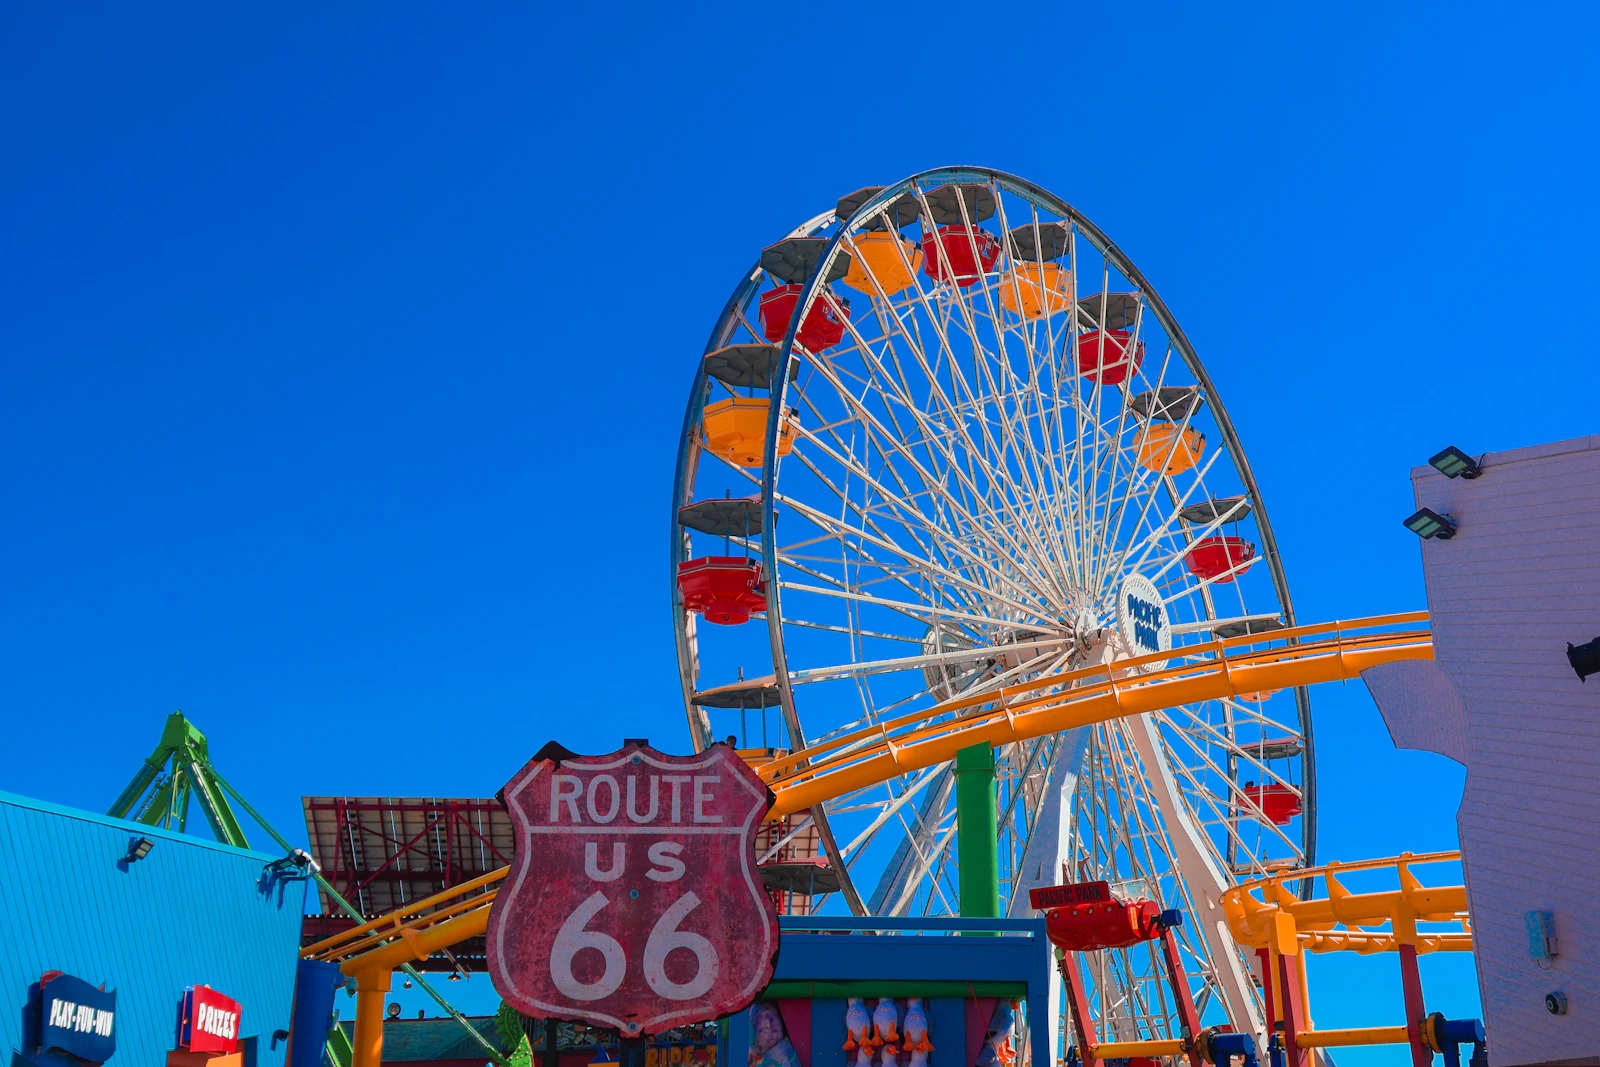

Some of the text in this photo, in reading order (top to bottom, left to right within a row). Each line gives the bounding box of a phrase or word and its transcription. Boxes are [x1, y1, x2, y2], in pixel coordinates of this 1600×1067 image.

[1127, 593, 1162, 631] PACIFIC
[550, 774, 723, 824] ROUTE
[1038, 884, 1102, 906] PACIFIC PARK
[550, 889, 719, 1001] 66
[197, 1002, 237, 1040] PRIZES
[645, 1045, 695, 1067] RIDE
